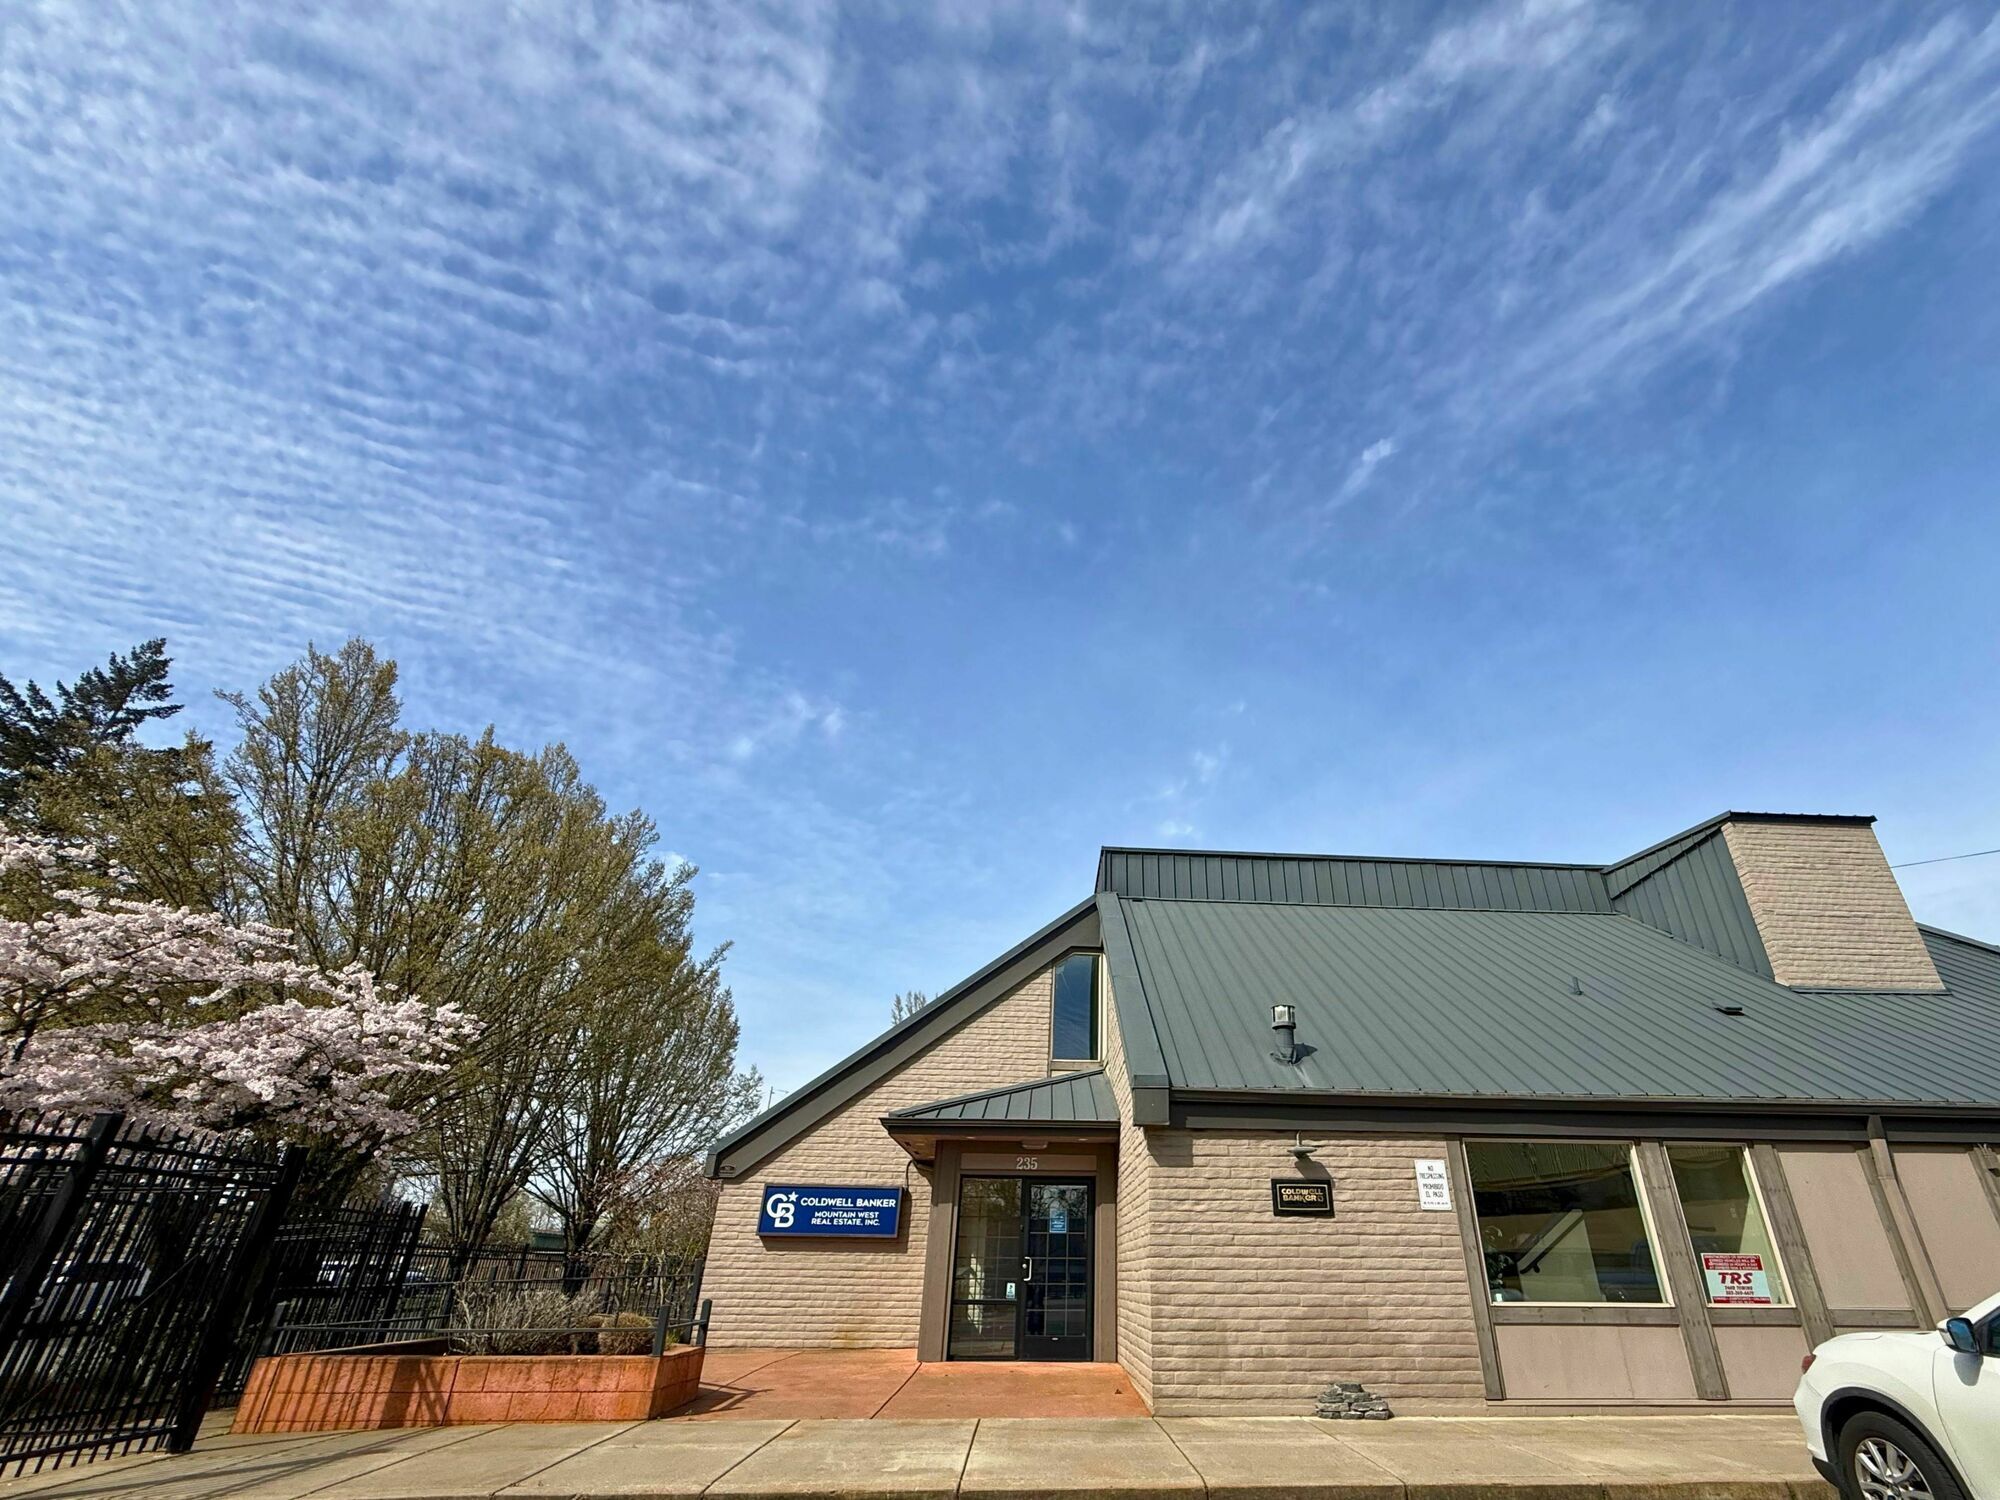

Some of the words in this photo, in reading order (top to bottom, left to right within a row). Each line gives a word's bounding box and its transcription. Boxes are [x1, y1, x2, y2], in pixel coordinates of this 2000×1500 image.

[1016, 1156, 1038, 1170] 235
[800, 1197, 854, 1207] COLDWELL
[856, 1198, 896, 1208] BANKER
[1282, 1194, 1317, 1202] BANKER
[858, 1211, 879, 1219] WEST
[1718, 1272, 1753, 1285] TRS
